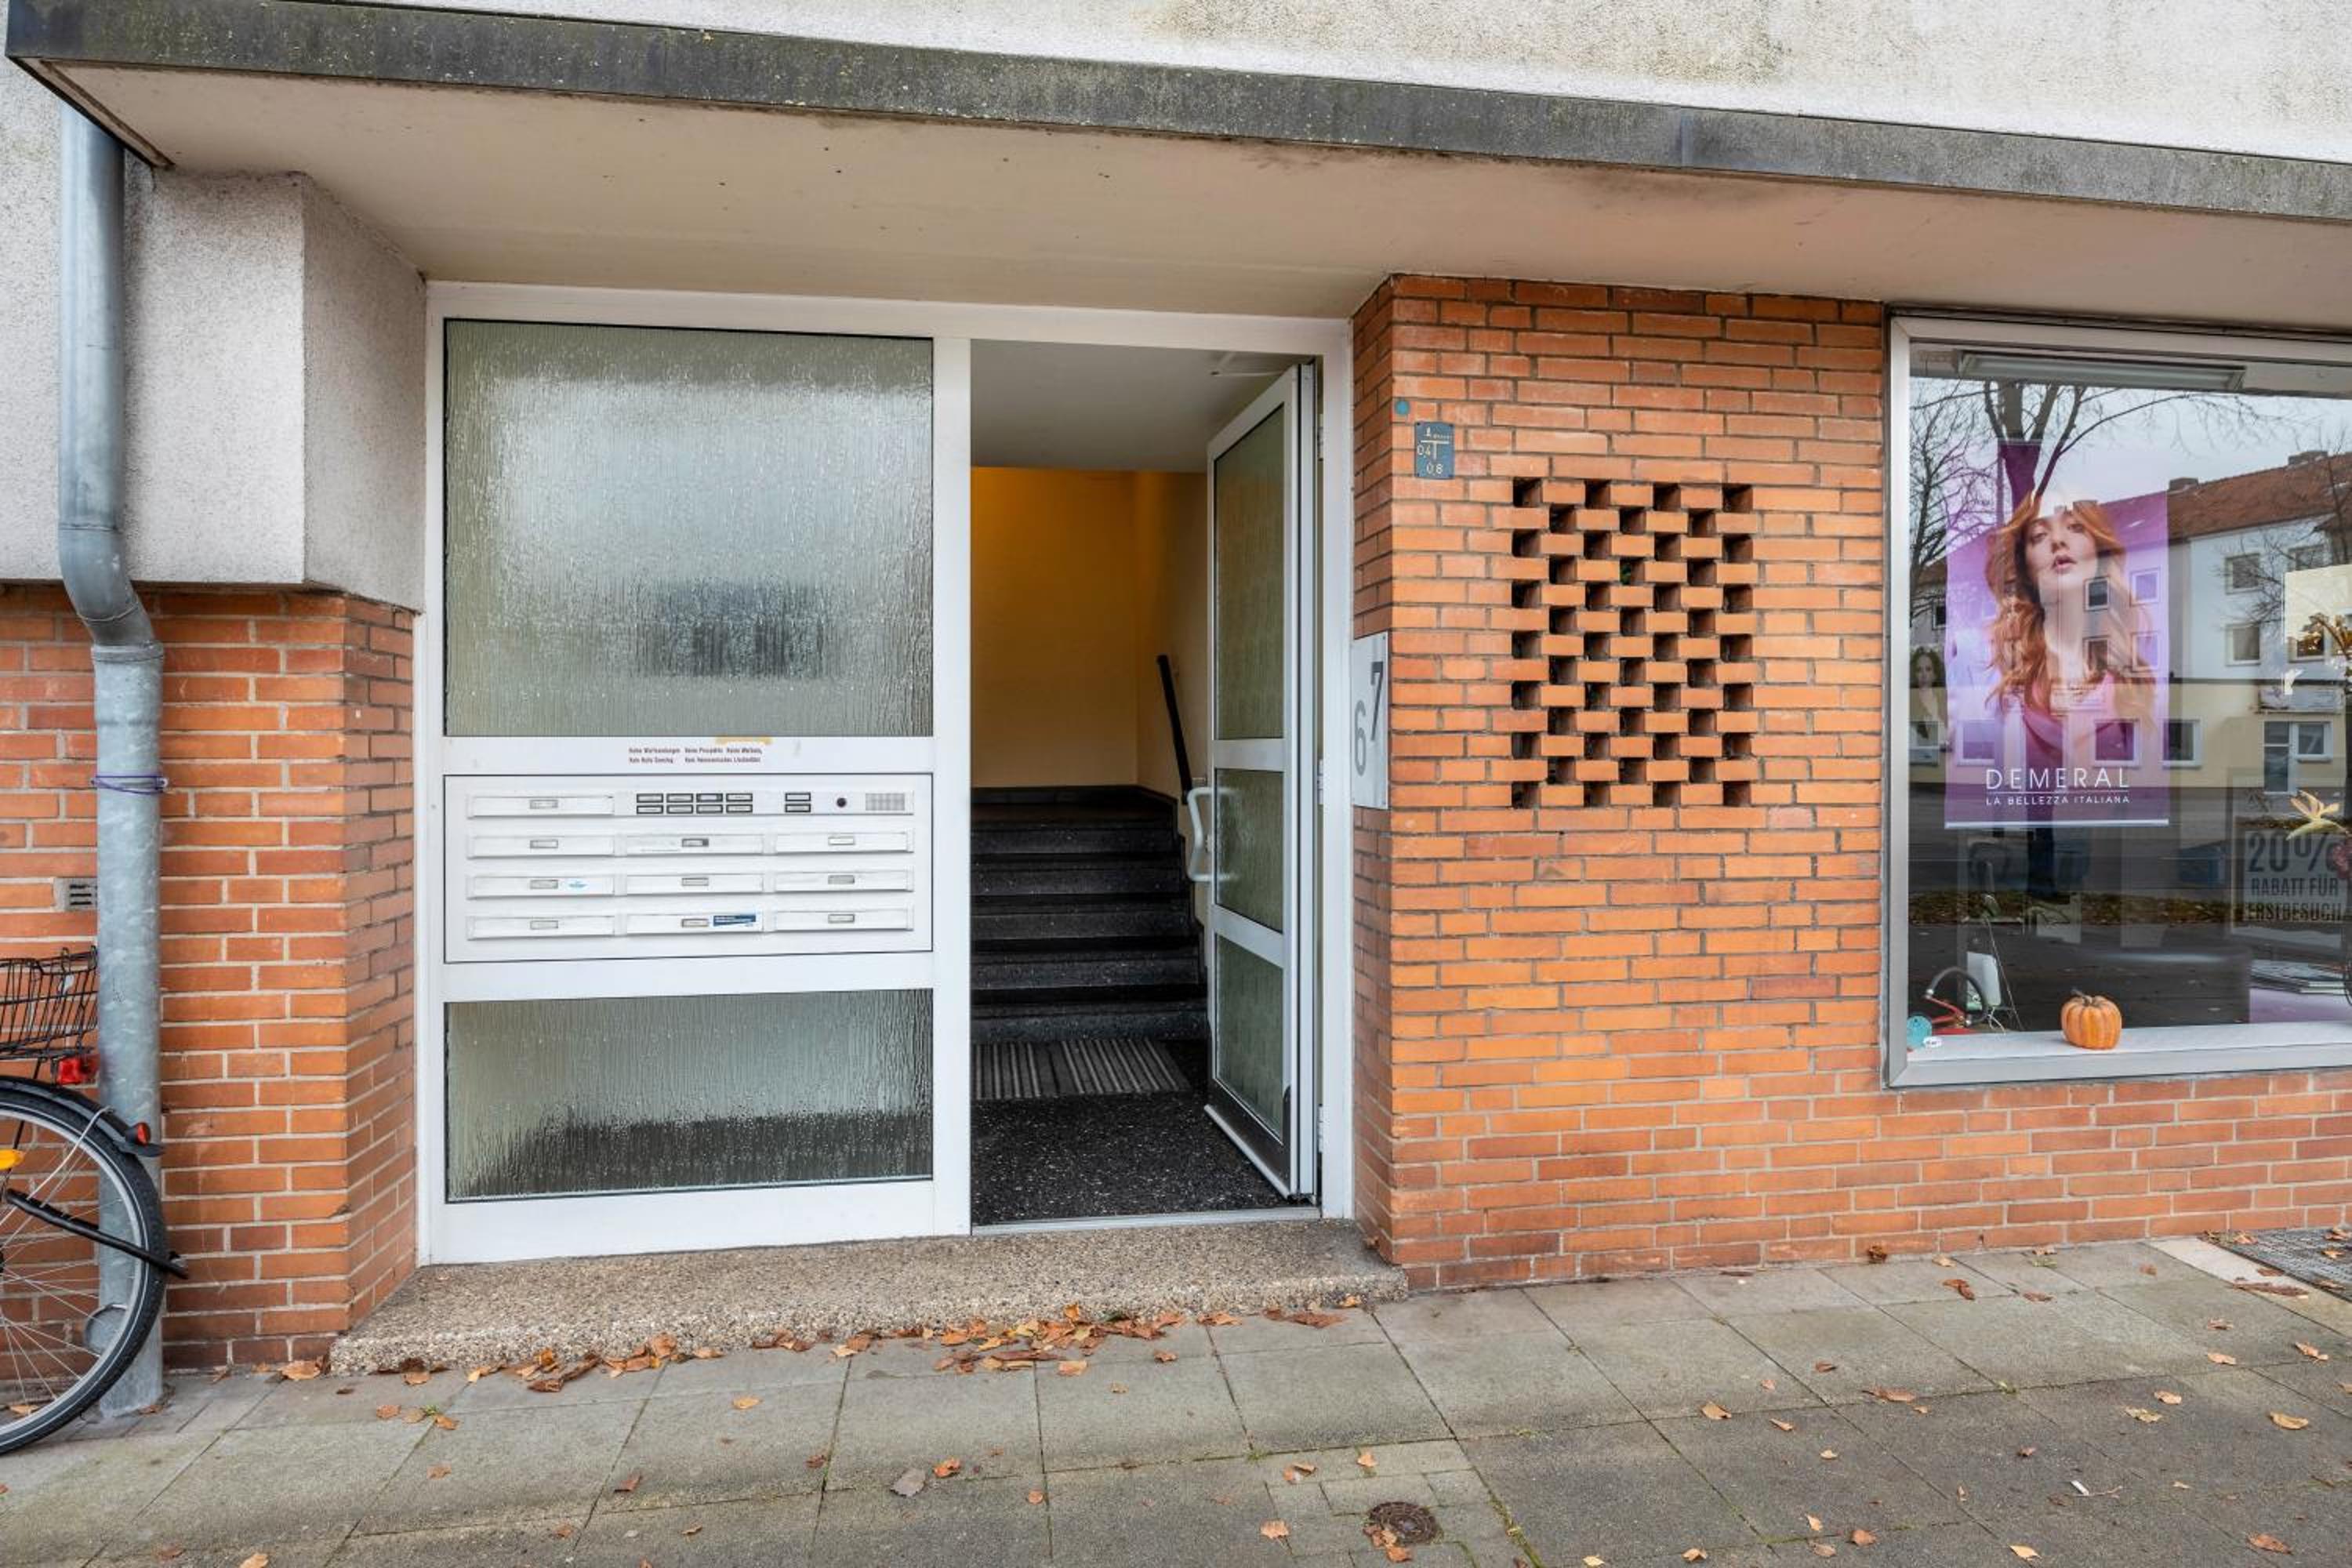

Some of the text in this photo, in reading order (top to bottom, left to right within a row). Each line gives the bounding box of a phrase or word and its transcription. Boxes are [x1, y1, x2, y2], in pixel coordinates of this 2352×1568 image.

[1986, 768, 2129, 789] DEMERAL
[1986, 794, 2130, 805] LA BELLEZZA ITALIANA
[2248, 830, 2341, 873] 20%
[2251, 873, 2339, 896] RABATT FÜR
